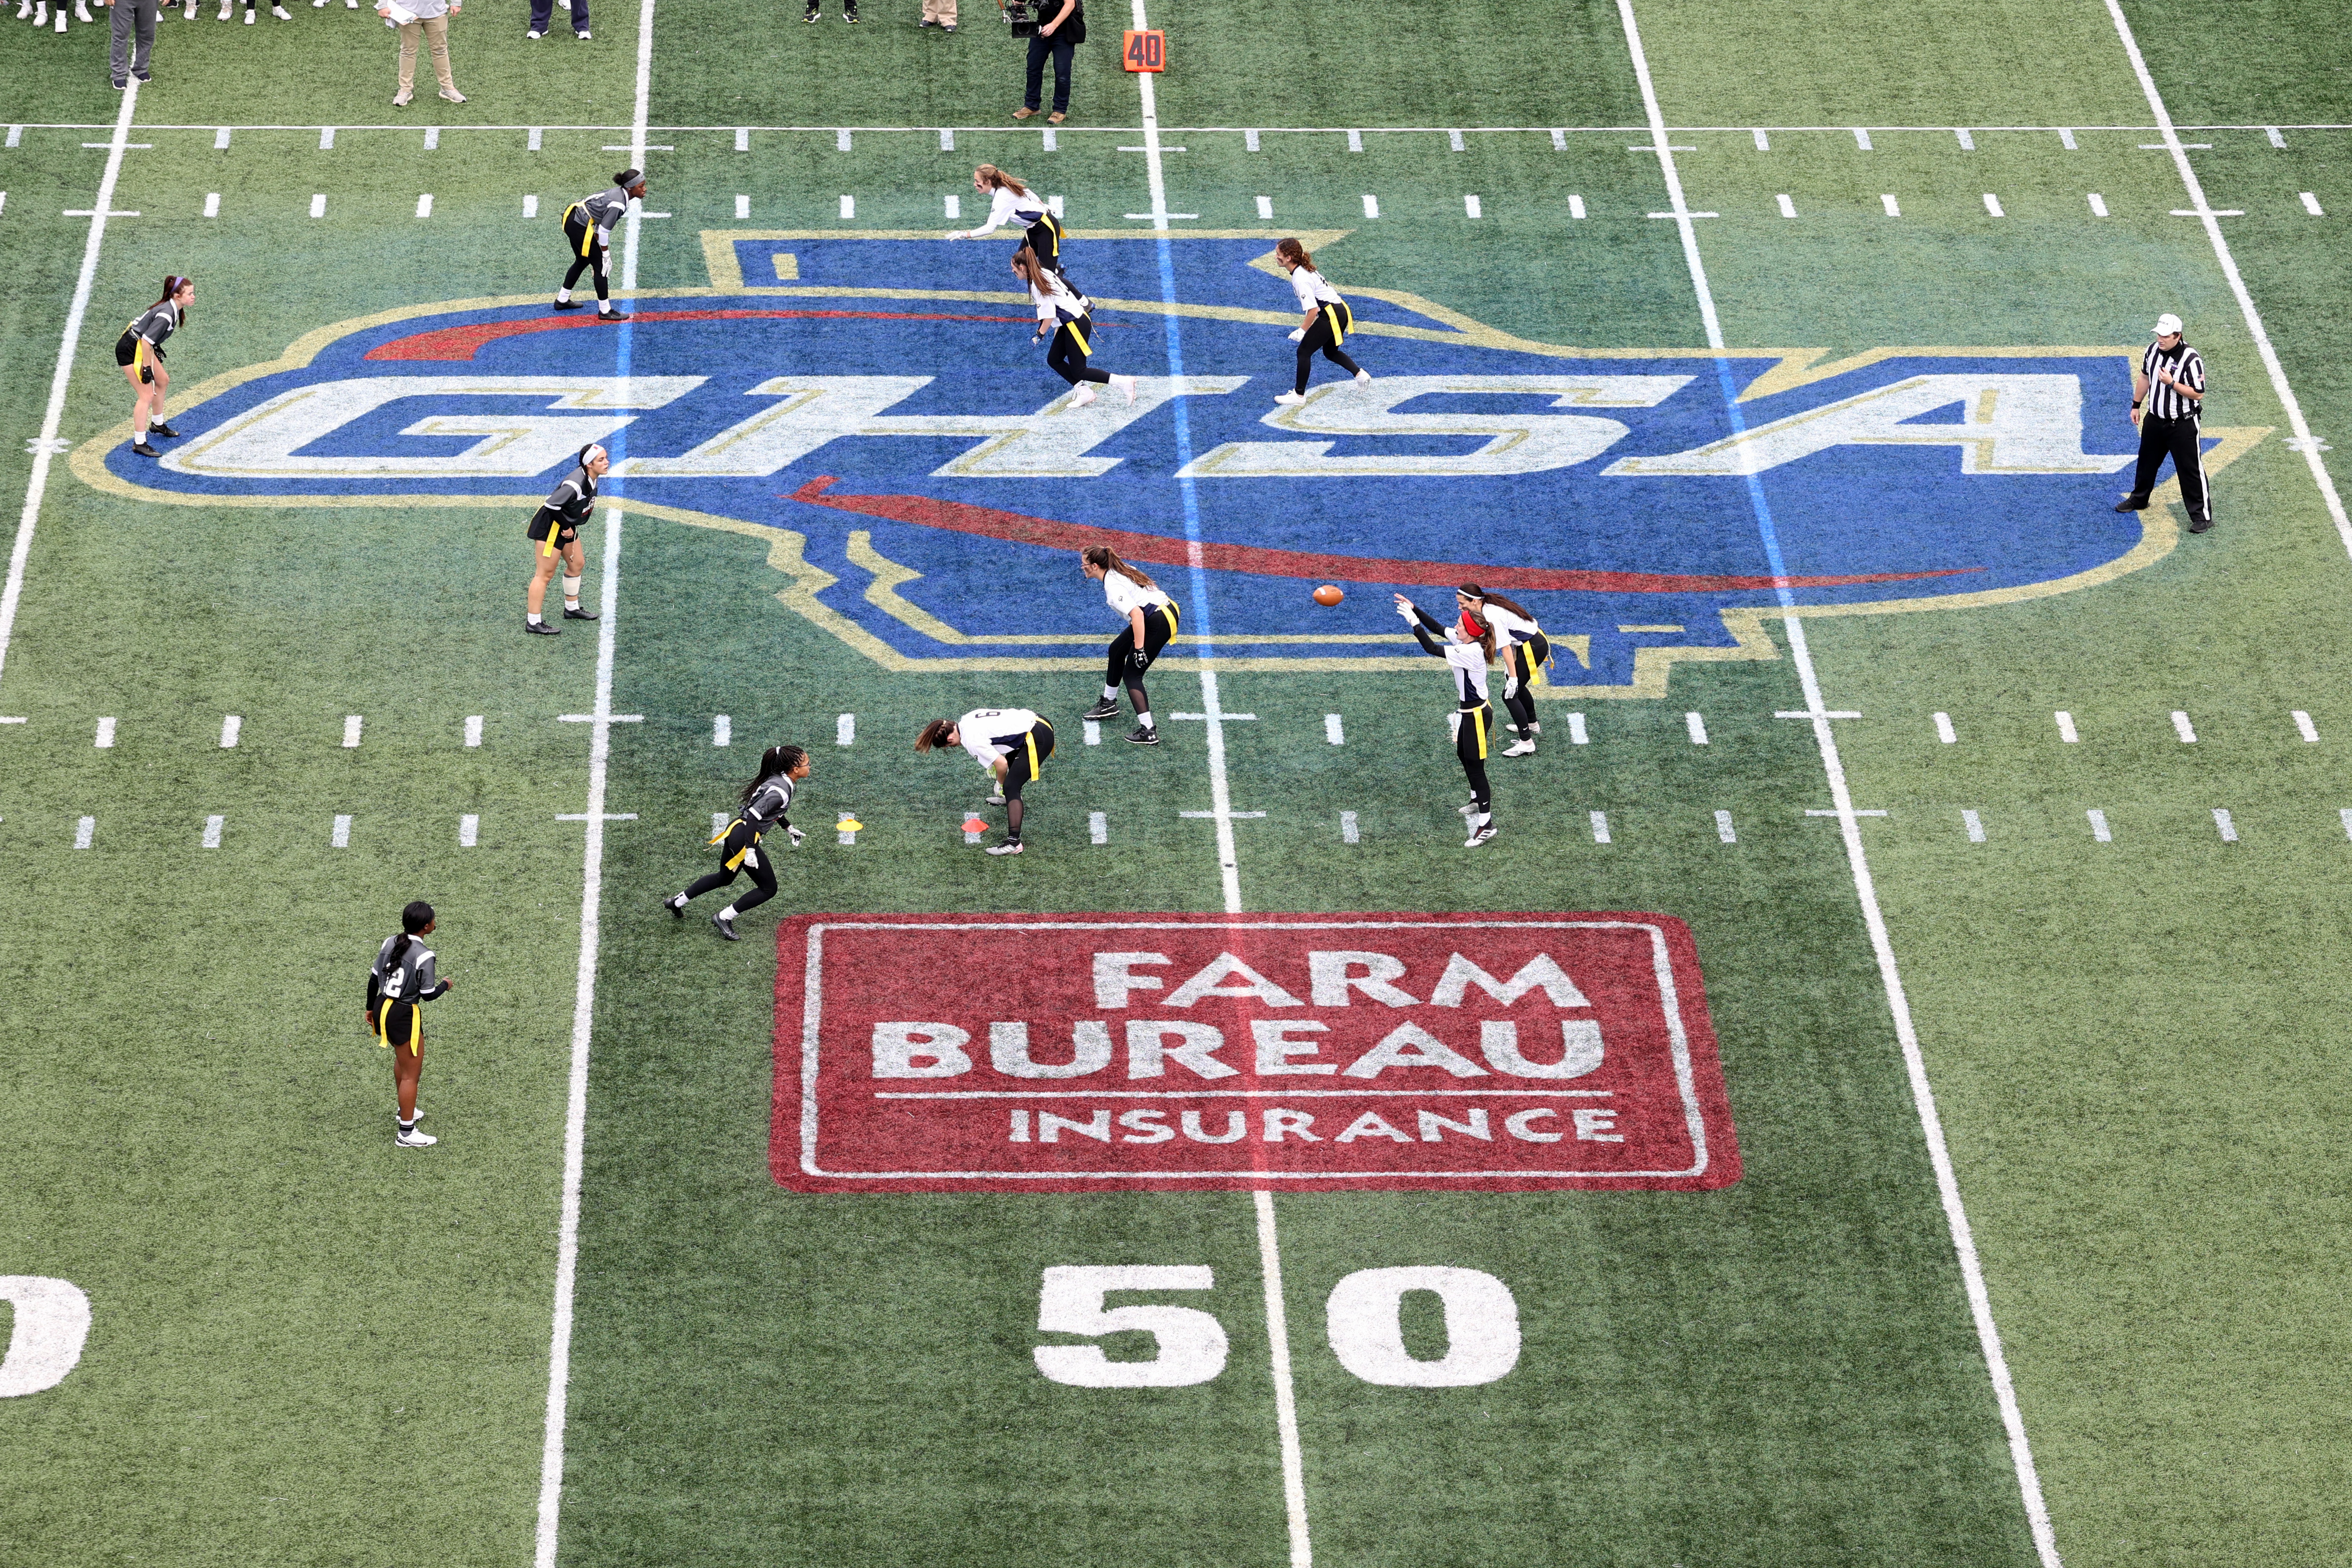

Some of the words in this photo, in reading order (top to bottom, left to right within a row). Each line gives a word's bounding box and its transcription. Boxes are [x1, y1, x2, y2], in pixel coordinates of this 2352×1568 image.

[1128, 35, 1160, 67] 40
[158, 373, 2139, 479] GHSA
[1092, 950, 1590, 1009] FARM
[871, 1019, 1604, 1080] BUREAU
[1009, 1107, 1623, 1144] INSURANCE
[1033, 1264, 1522, 1387] 50
